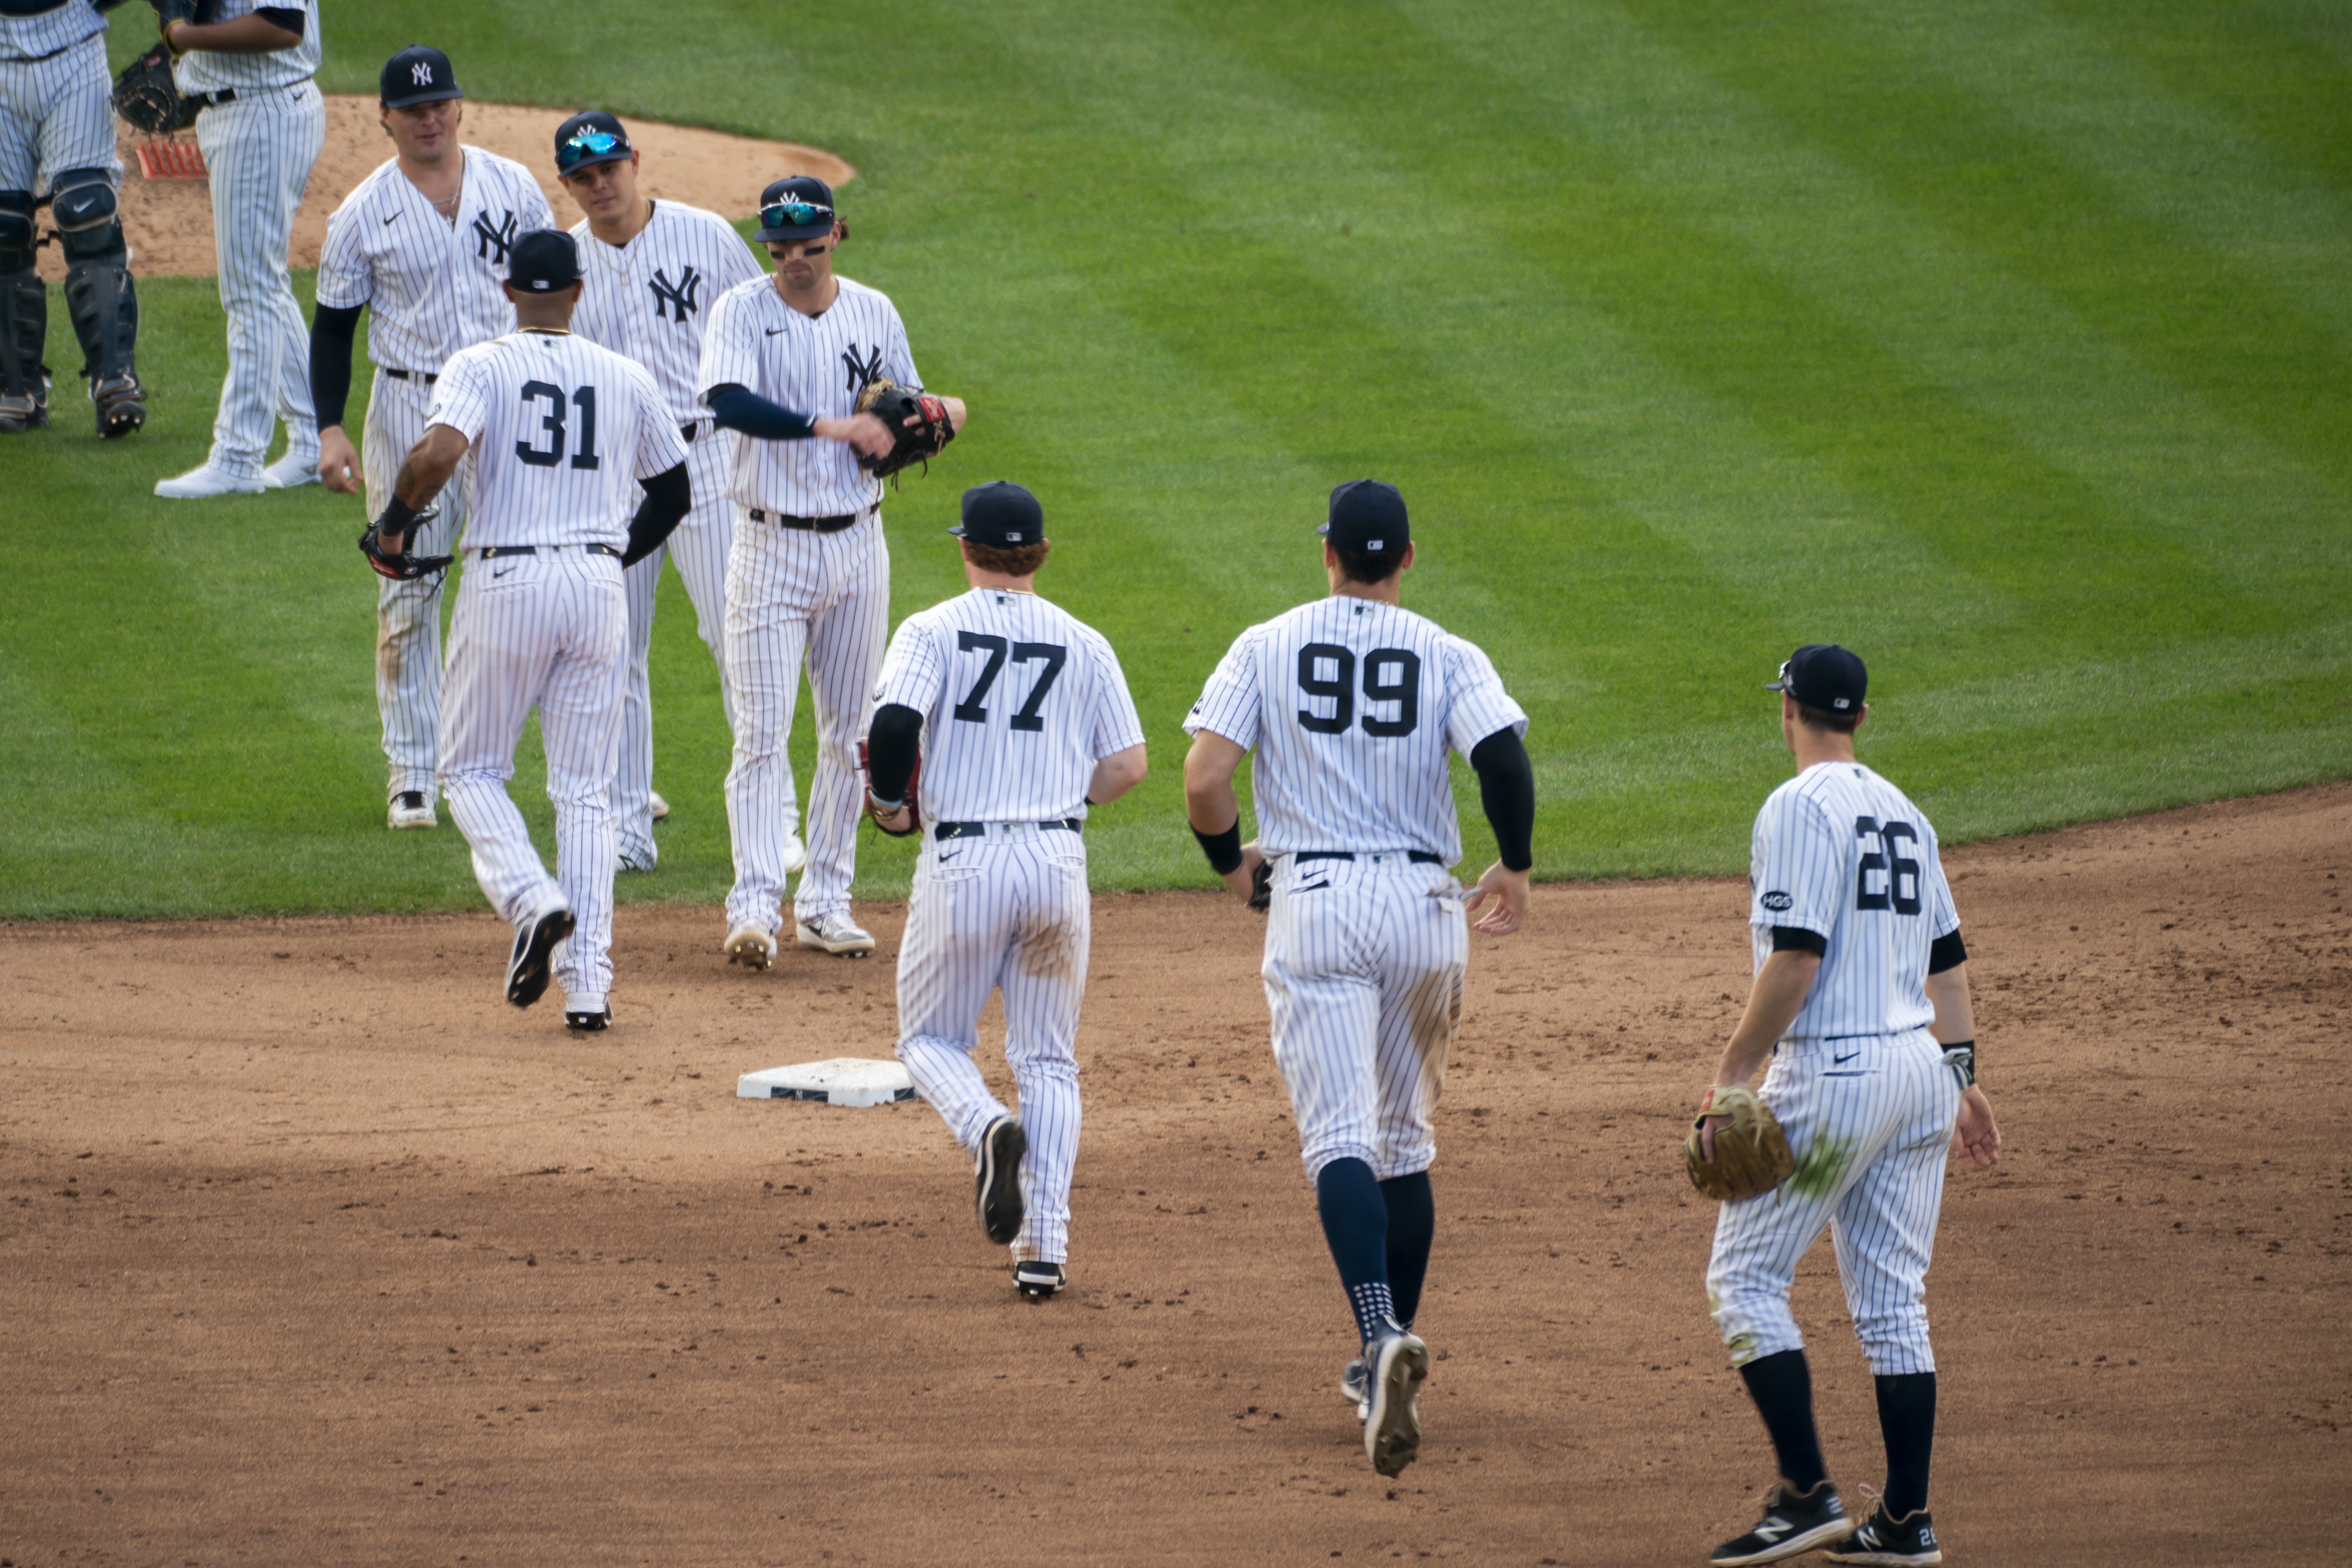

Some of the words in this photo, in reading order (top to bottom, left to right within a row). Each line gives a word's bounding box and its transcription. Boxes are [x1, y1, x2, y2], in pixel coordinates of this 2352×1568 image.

[411, 62, 433, 86] NY
[472, 209, 518, 264] NY
[648, 265, 701, 323] NY
[841, 342, 882, 398] NY
[516, 380, 599, 470] 31
[954, 630, 1067, 731] 77
[1298, 642, 1420, 737] 99
[1856, 816, 1921, 916] 26
